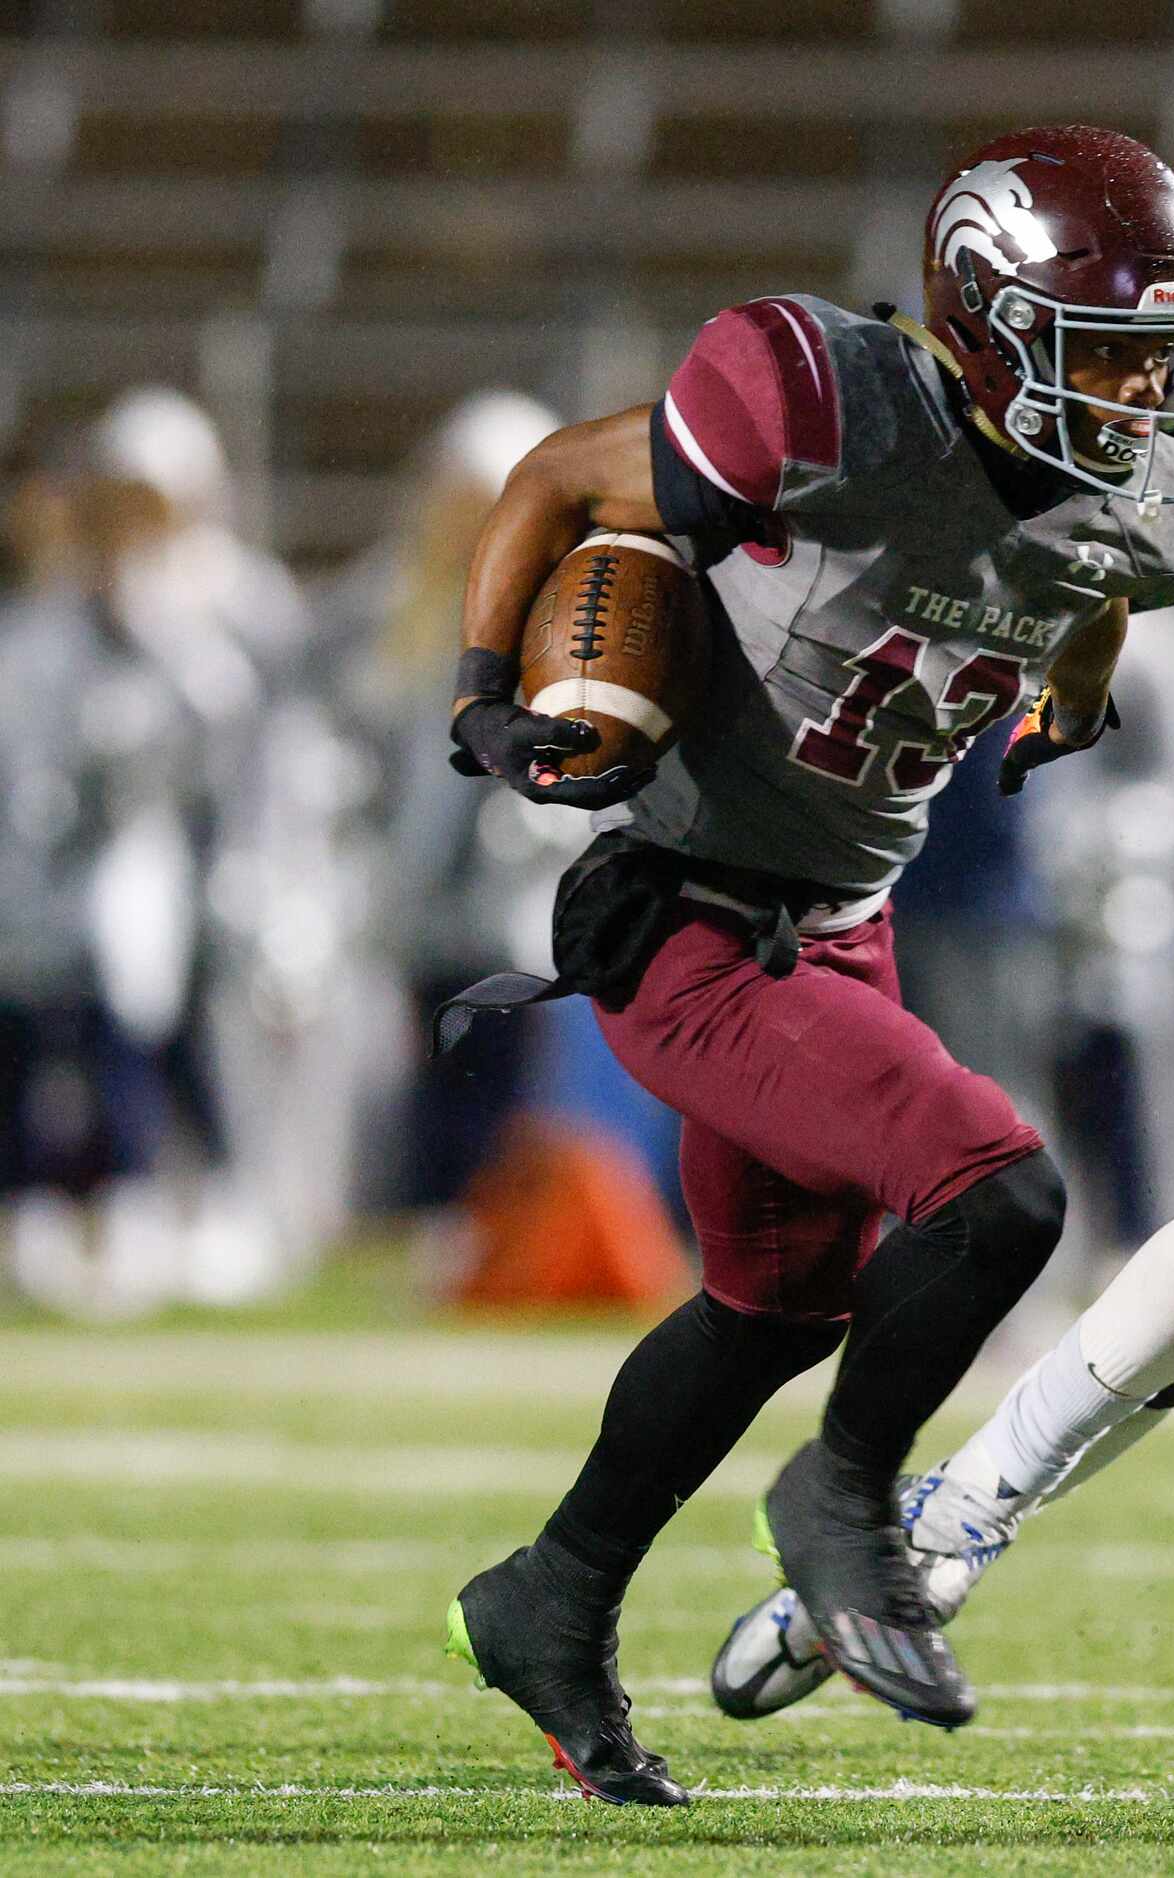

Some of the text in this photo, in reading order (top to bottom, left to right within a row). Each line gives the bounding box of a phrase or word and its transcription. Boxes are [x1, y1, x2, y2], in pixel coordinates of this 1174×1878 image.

[905, 586, 1056, 646] THE PACK
[785, 625, 1028, 795] 13
